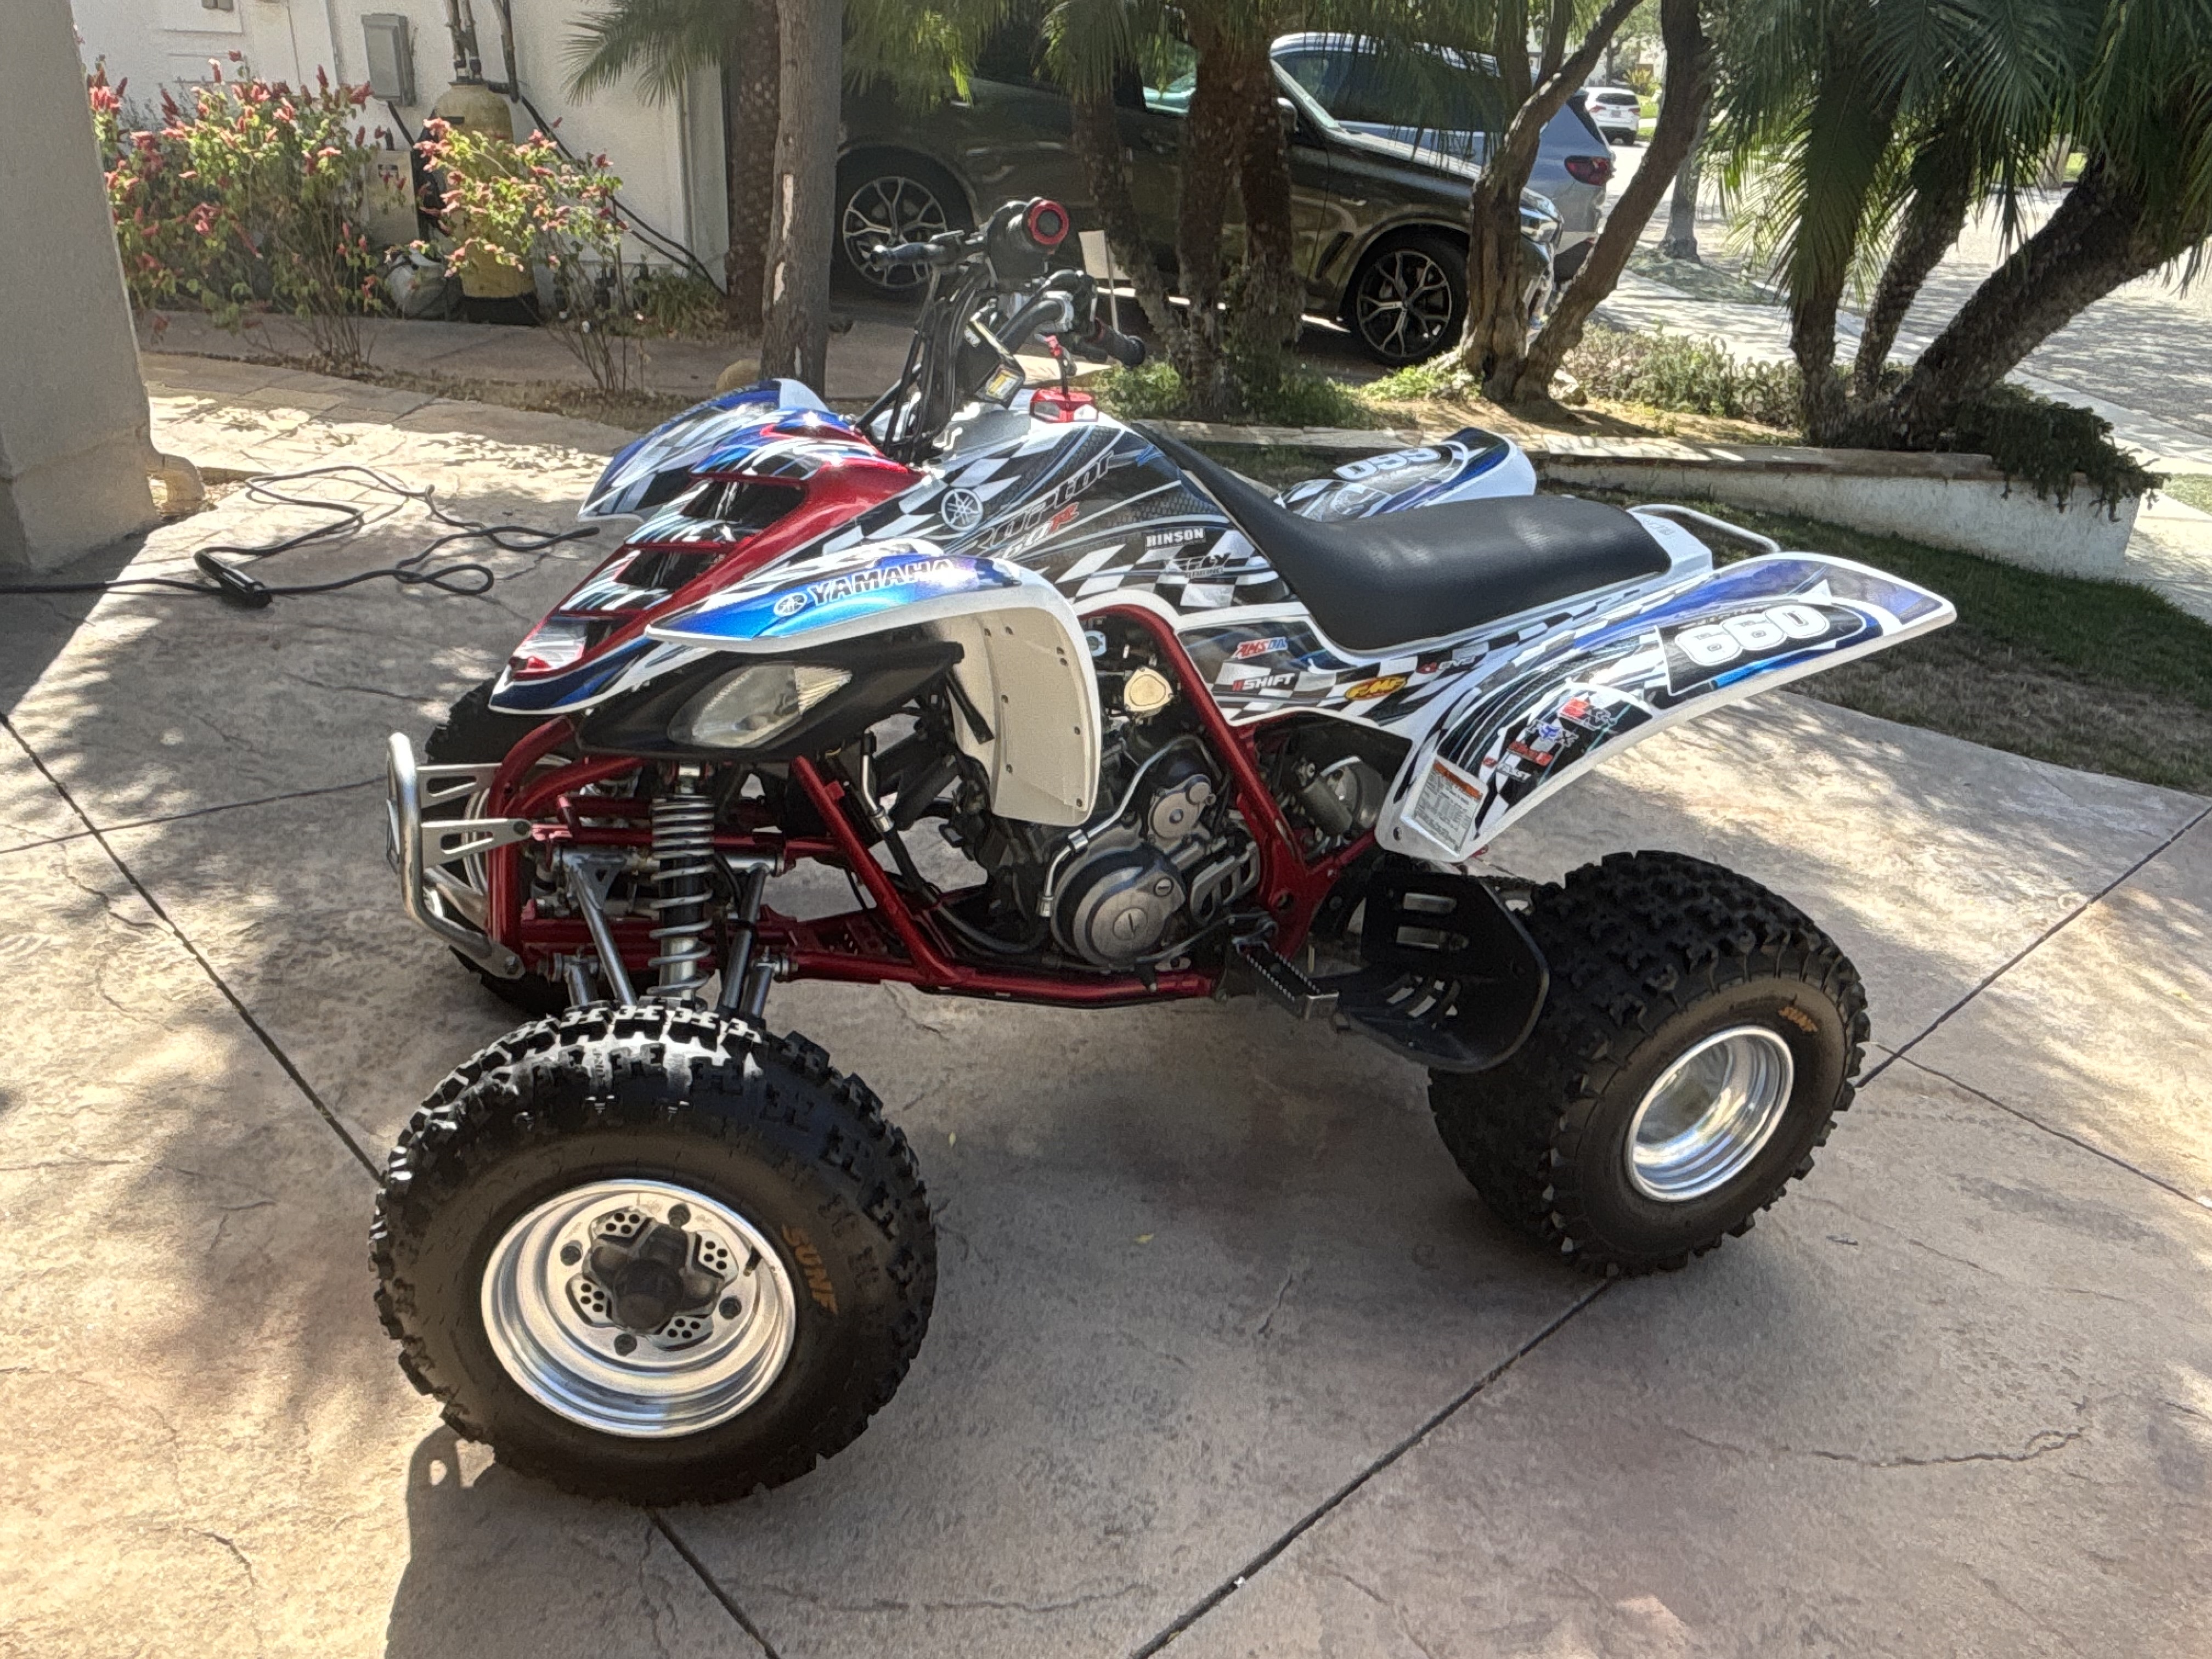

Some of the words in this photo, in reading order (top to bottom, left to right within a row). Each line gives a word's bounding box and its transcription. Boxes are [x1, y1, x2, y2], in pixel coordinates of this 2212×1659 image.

[1147, 528, 1204, 548] HINSON
[1674, 604, 1830, 666] 660
[1235, 638, 1287, 658] AMSOIL
[1243, 673, 1295, 690] SHIFT
[1346, 678, 1406, 697] FMF
[781, 1223, 839, 1314] SUNF
